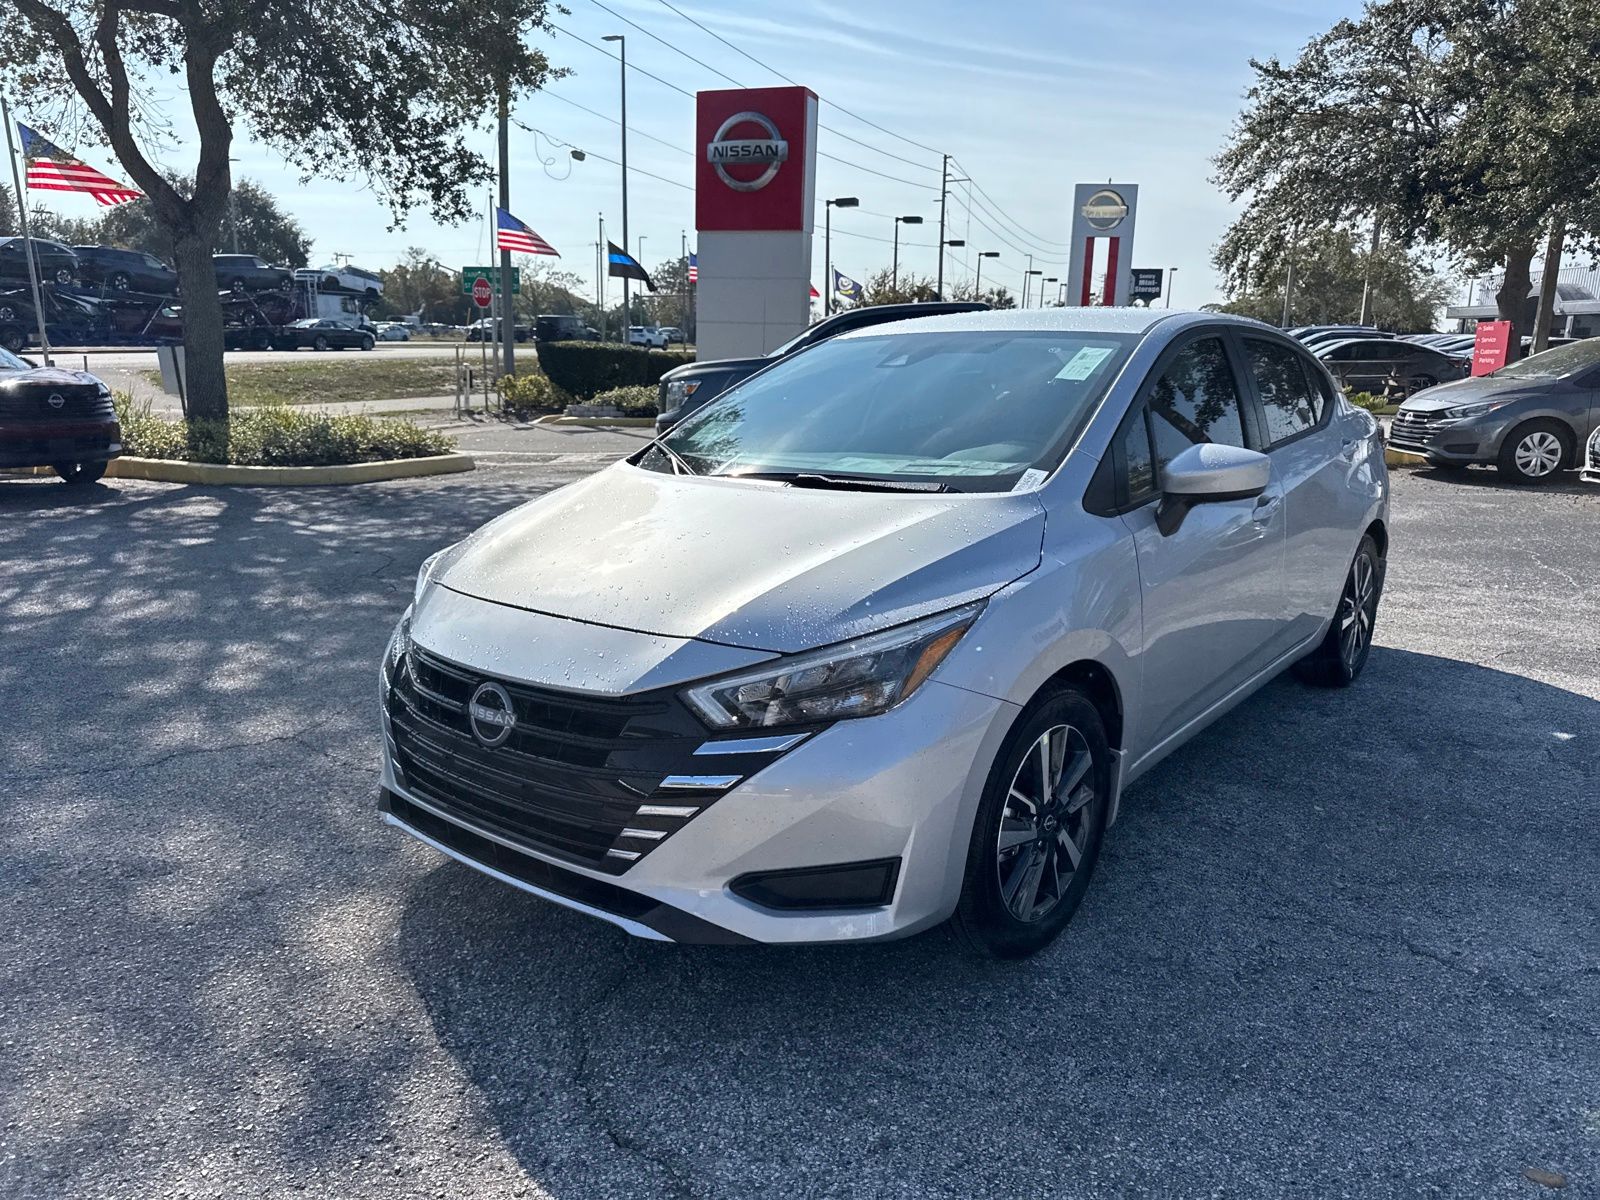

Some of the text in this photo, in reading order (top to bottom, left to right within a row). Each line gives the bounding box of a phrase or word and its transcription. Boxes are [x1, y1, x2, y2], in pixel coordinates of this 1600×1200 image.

[712, 144, 779, 158] NISSAN
[474, 287, 491, 298] STOP
[469, 702, 515, 726] NISSAN
